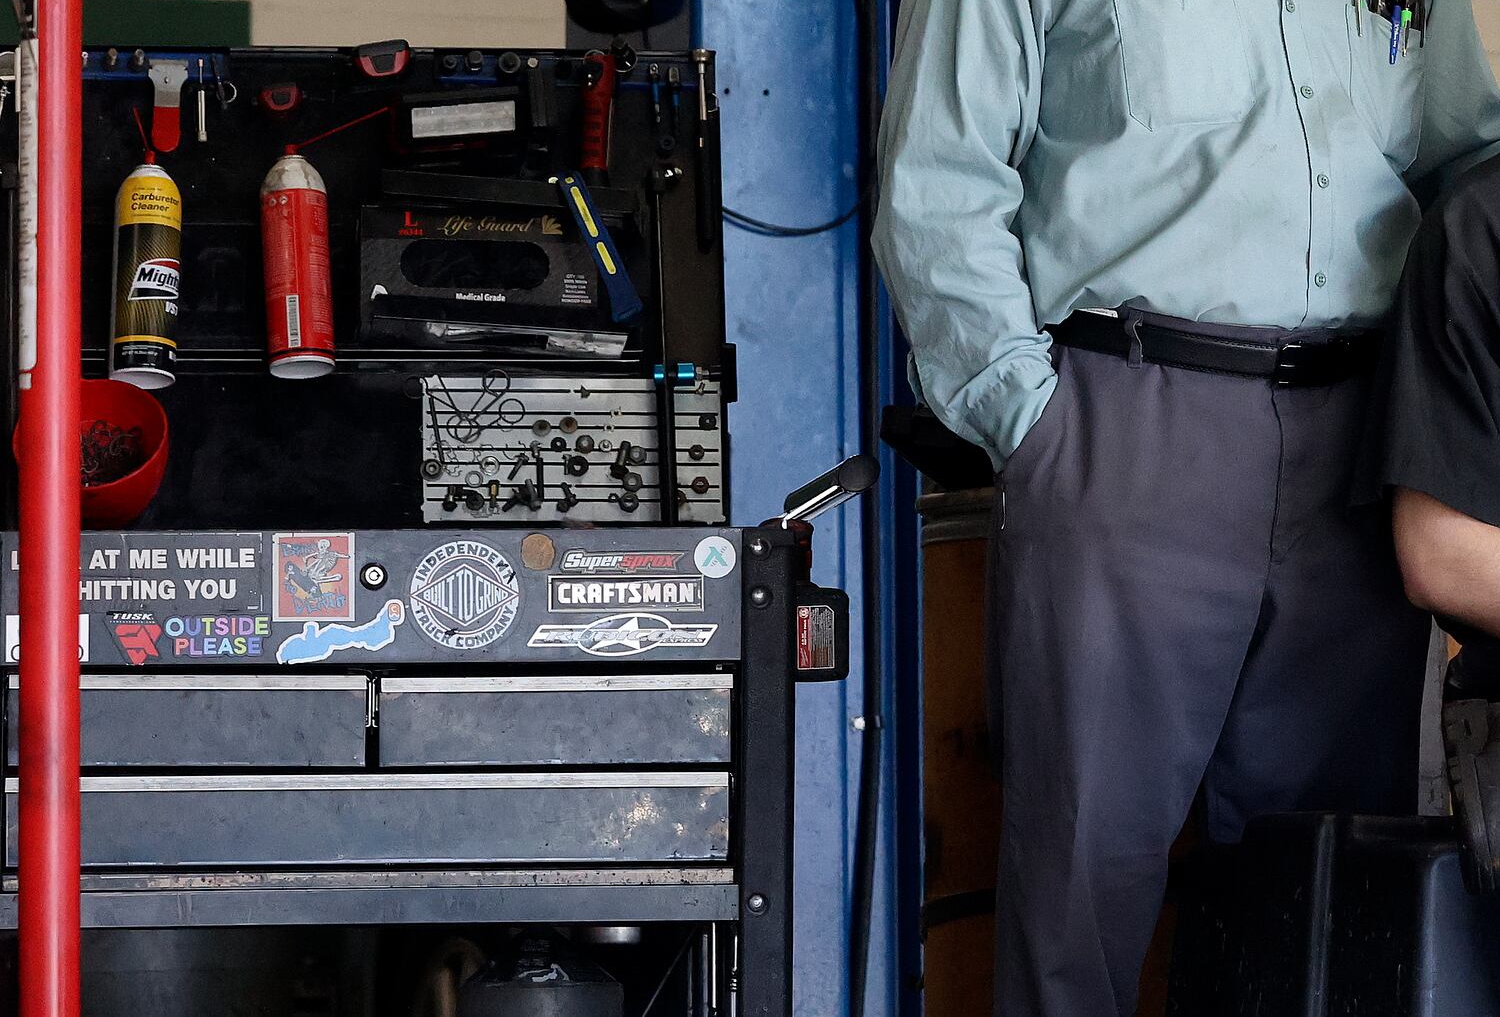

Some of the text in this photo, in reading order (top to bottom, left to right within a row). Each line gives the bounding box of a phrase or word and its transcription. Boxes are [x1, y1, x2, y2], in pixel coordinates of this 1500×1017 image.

[131, 202, 170, 212] Cleaner
[404, 211, 418, 227] L
[137, 267, 179, 287] Might
[455, 292, 506, 303] Medical Grade
[89, 549, 120, 570] AT
[130, 549, 168, 570] ME
[176, 548, 256, 569] WHILE
[78, 579, 237, 601] HITTING YOU
[423, 567, 509, 622] BUILT TO GRIND
[557, 582, 694, 605] CRAFTSMAN
[113, 612, 153, 620] TUSK
[415, 602, 514, 648] TRUCK COMPANY
[165, 616, 270, 638] OUTSIDE
[175, 637, 263, 656] PLEASE
